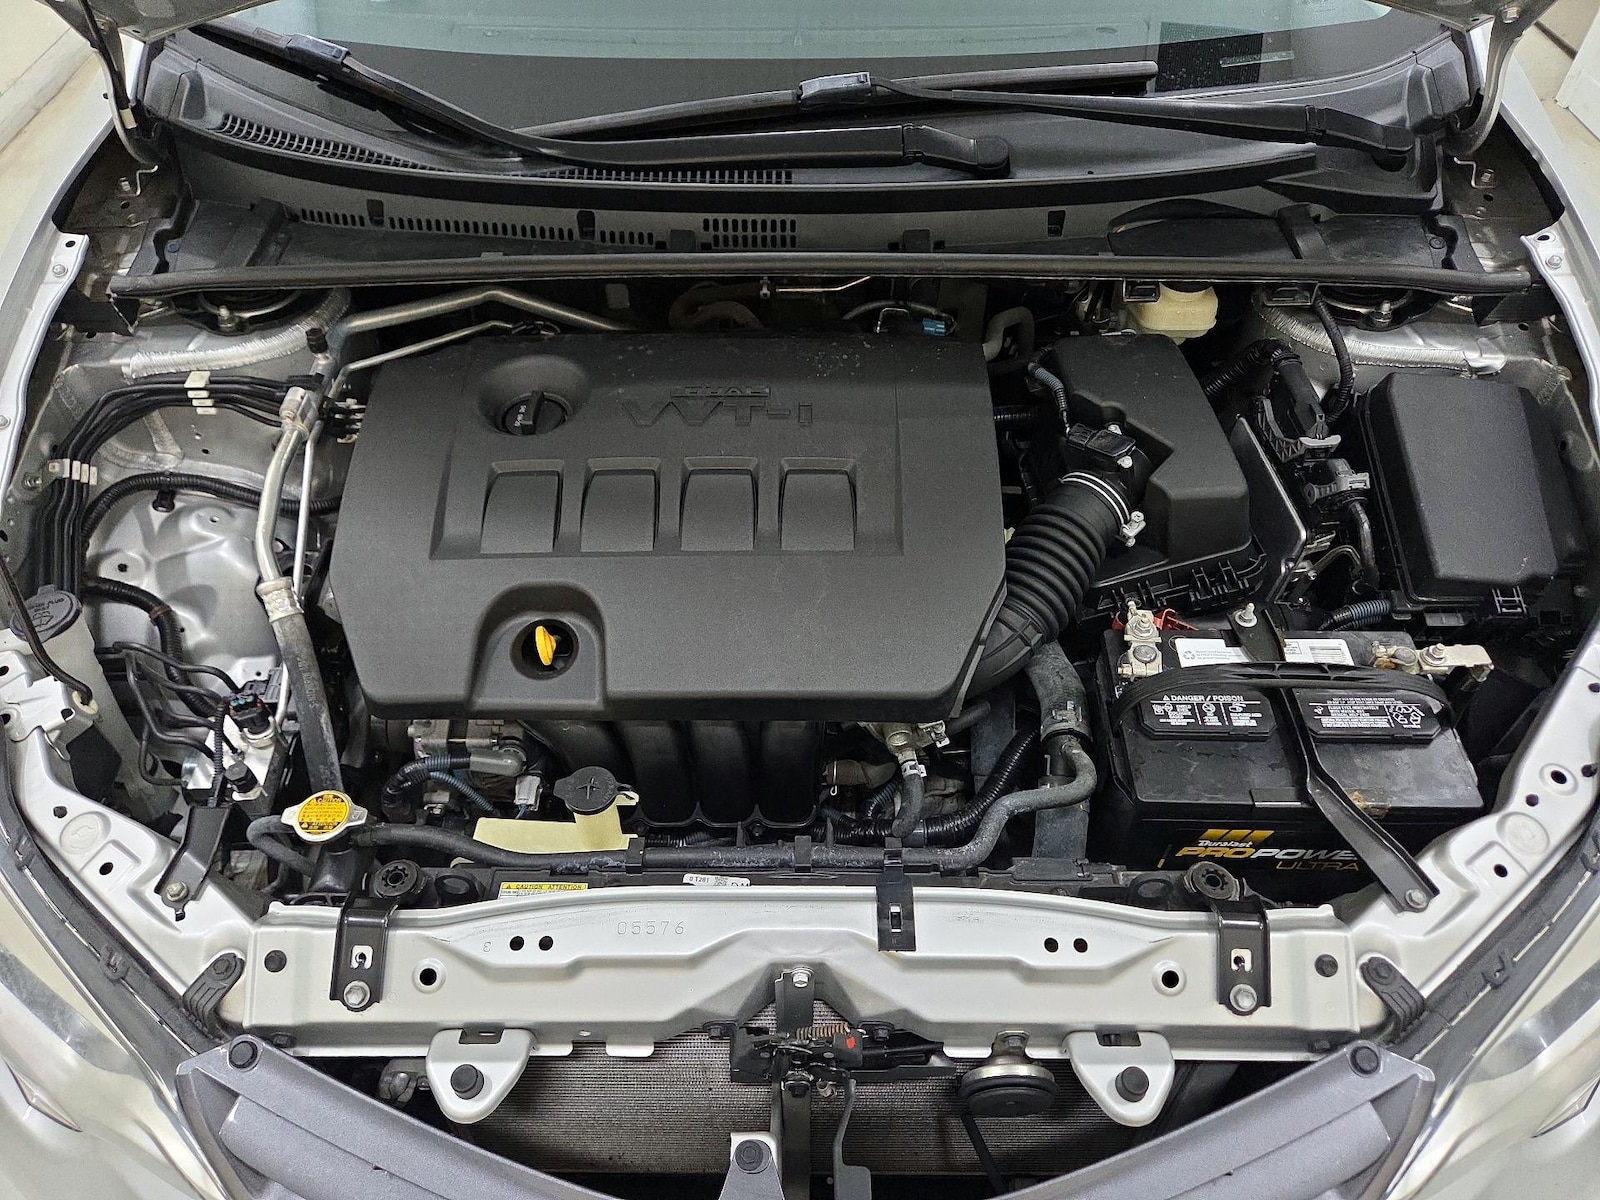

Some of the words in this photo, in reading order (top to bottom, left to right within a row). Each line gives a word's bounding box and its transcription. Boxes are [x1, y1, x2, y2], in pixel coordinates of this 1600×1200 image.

[1198, 840, 1254, 848] Duralast
[1176, 847, 1358, 861] PROPOWE
[1276, 861, 1360, 872] ULTRA
[516, 883, 543, 891] CAUTION
[547, 883, 583, 891] ATTENTION
[617, 920, 687, 935] 05576
